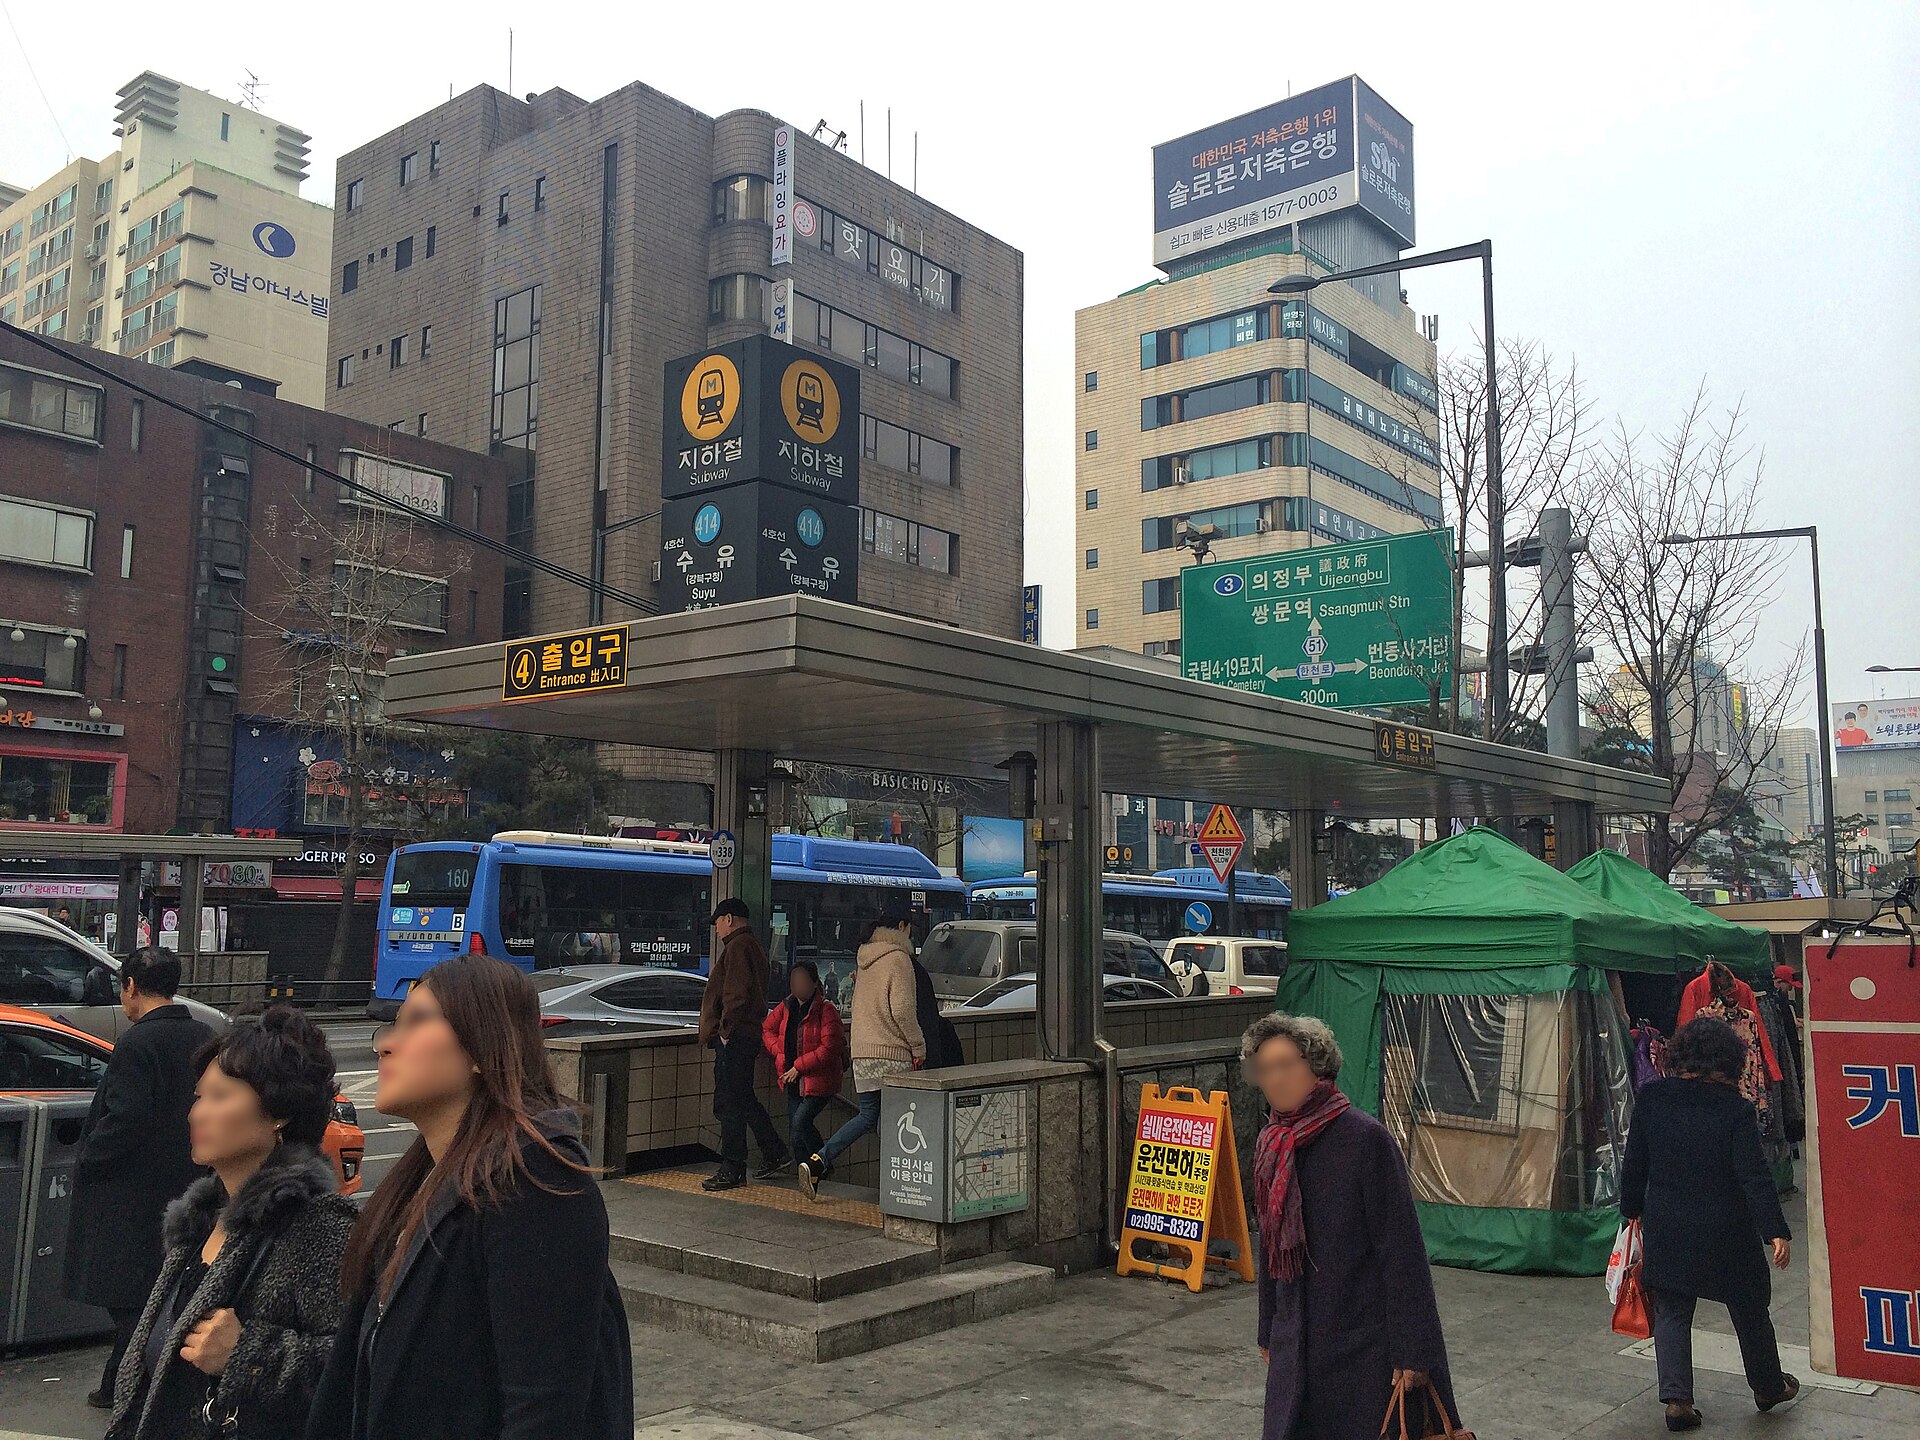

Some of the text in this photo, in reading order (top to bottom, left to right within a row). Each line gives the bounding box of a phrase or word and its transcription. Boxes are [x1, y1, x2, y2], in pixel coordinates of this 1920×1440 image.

[1192, 106, 1337, 168] 대한민국 저축은행 1위
[1167, 128, 1338, 210] 솔로몬저축은행
[1362, 164, 1411, 215] 솔로몬저축은행
[775, 149, 787, 250] 플라잉요가
[1170, 186, 1338, 250] 쉽고 빠른 신용대출 1577-0003
[209, 261, 328, 318] 경남아너스빌
[1236, 316, 1254, 328] 피부
[1236, 330, 1254, 342] 비만
[678, 437, 742, 470] 지하철
[778, 440, 843, 478] 지하철
[690, 467, 731, 486] Subway
[790, 468, 831, 491] Subway
[695, 513, 718, 536] 414
[799, 516, 820, 540] 414
[664, 537, 685, 551] 4호선
[762, 528, 786, 542] 4호선
[676, 544, 734, 572] 수유
[779, 548, 840, 580] 수유
[1319, 553, 1368, 573] 議政府
[686, 571, 723, 586] (강북구청)
[790, 574, 829, 592] (강북구청)
[1224, 578, 1234, 592] 3
[1252, 565, 1312, 592] 의정부
[1319, 568, 1383, 588] Uijeongbu
[692, 588, 716, 600] Suyu
[1251, 596, 1410, 625] 쌍문역 Ssangmun Stn
[1308, 640, 1322, 652] 51
[1368, 635, 1449, 664] 번동사거리
[516, 634, 621, 684] 4 출입구
[1188, 654, 1263, 680] 국립4·19묘지
[540, 666, 620, 688] Entrance 出入口
[1300, 664, 1332, 677] 한천로
[1300, 690, 1338, 704] 300m
[1382, 729, 1433, 754] 4 출입구
[872, 774, 908, 790] BASIC
[289, 850, 376, 864] OGER PRSO
[718, 847, 732, 858] 338
[1211, 848, 1232, 857] 천천히
[1214, 856, 1230, 864] SLOW
[448, 869, 470, 888] 160
[34, 885, 59, 894] 광대역
[62, 886, 86, 895] LTE!
[912, 892, 922, 900] 160
[454, 916, 462, 928] B
[630, 942, 691, 952] 캡틴 아메리카
[1142, 1114, 1214, 1148] 실내운전연습실
[890, 1156, 932, 1172] 편의시설
[1136, 1144, 1195, 1180] 운전면허
[1195, 1152, 1210, 1166] 기능
[890, 1169, 932, 1185] 이용안내
[1194, 1167, 1208, 1182] 주행
[1132, 1188, 1165, 1210] 운전면허에
[1166, 1194, 1180, 1214] 관한
[1130, 1213, 1198, 1239] 02)995-8328
